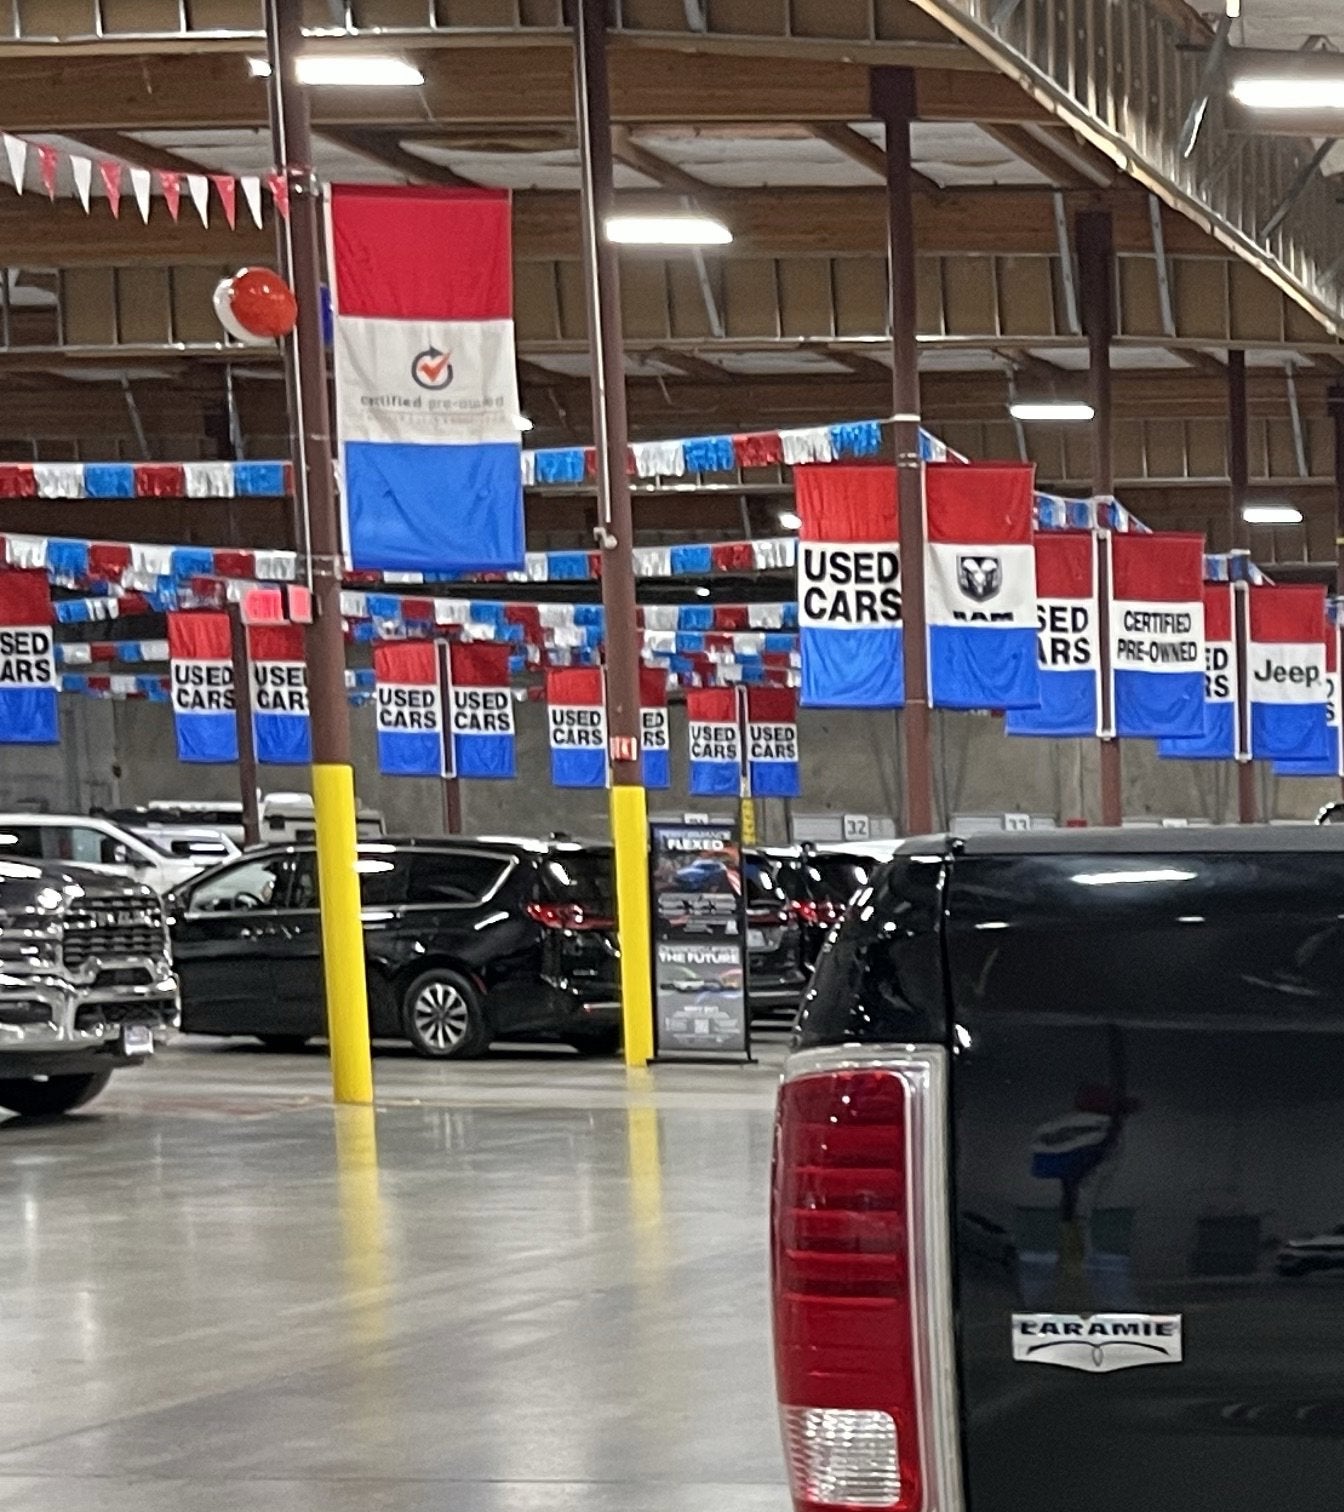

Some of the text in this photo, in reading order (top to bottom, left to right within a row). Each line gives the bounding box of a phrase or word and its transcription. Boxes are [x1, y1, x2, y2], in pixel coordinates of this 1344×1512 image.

[804, 549, 899, 585] USED
[804, 586, 902, 623] CARS
[1037, 605, 1090, 634] SED
[1123, 610, 1192, 634] CERTIFIED
[0, 632, 49, 656] SED
[1117, 638, 1198, 663] PRE-OWNED
[0, 659, 51, 683] ARS
[175, 664, 234, 687] USED
[255, 666, 306, 687] USE
[1254, 659, 1320, 687] Jeep
[176, 688, 236, 710] CARS
[257, 689, 308, 710] CAR
[379, 688, 435, 708] USED
[454, 690, 508, 710] USED
[379, 709, 437, 729] CARS
[454, 711, 511, 732] CARS
[552, 709, 601, 727] USED
[642, 713, 664, 728] ED
[552, 728, 604, 746] CARS
[643, 730, 666, 747] RS
[691, 726, 735, 742] USED
[750, 726, 795, 742] USED
[691, 743, 737, 759] CARS
[750, 743, 796, 759] CARS
[667, 838, 723, 851] FLEXED
[659, 952, 739, 964] THE FUTURE
[1020, 1322, 1174, 1337] LARAMIE
